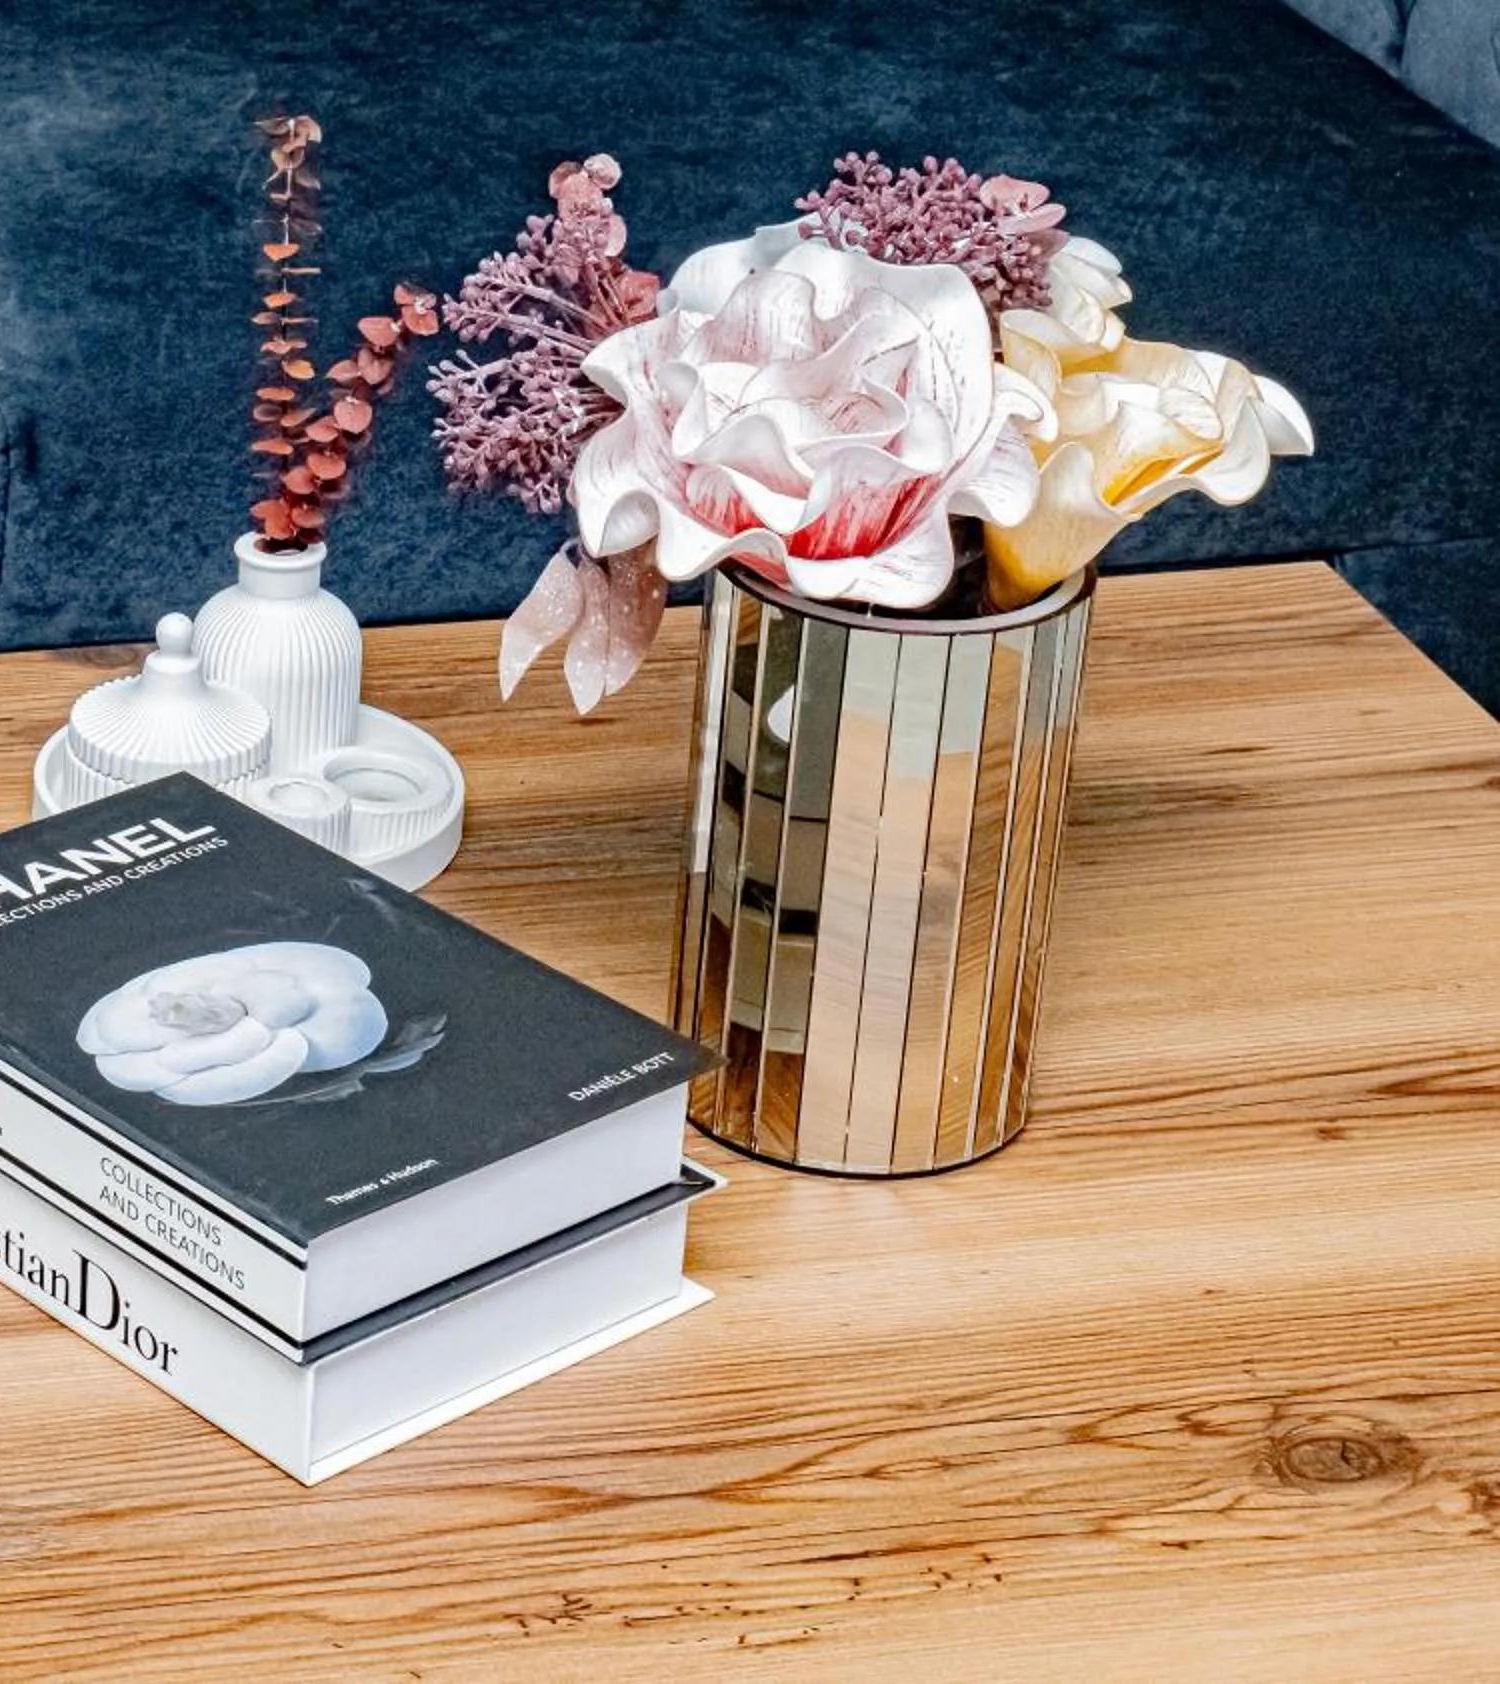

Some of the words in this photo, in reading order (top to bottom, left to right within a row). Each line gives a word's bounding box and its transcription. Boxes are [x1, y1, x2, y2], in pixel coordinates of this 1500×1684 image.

[83, 875, 123, 896] AND
[124, 836, 228, 880] CREATIONS
[632, 1051, 675, 1075] BOTT
[389, 1158, 439, 1182] Hudson
[100, 1157, 221, 1246] COLLECTIONS
[100, 1186, 139, 1220] AND
[145, 1213, 245, 1290] CREATIONS
